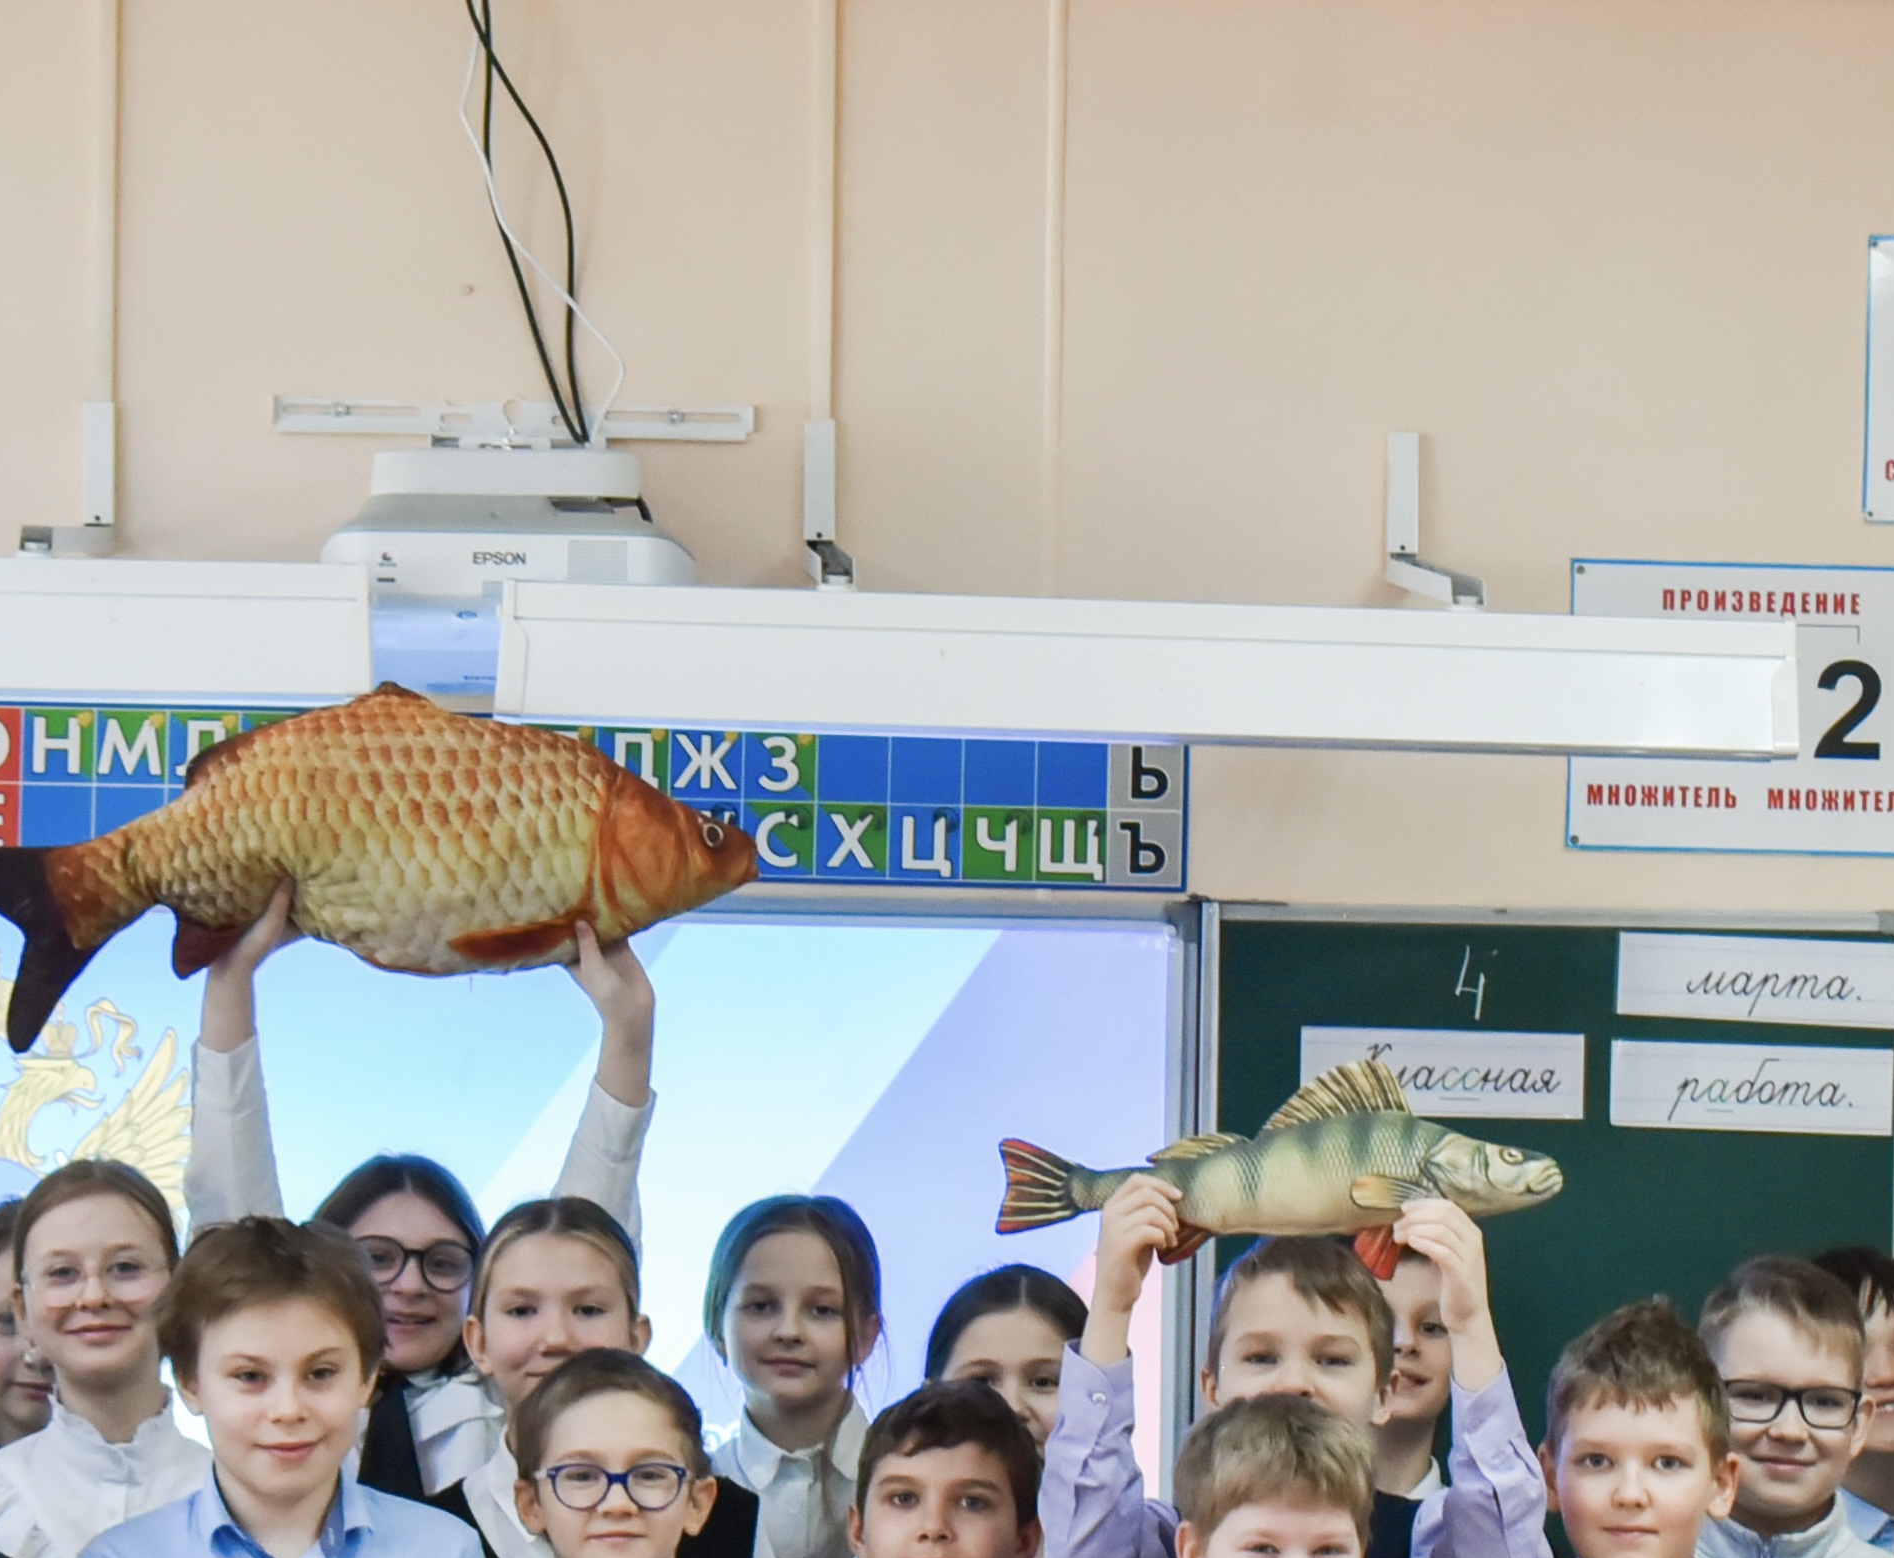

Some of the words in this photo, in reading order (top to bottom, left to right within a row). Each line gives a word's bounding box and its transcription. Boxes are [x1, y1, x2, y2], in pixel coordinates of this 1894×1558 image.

[473, 552, 527, 566] EPSON
[1662, 589, 1862, 618] ПРОИЗВЕДЕНИЕ
[1813, 659, 1883, 761] 2
[1587, 784, 1738, 810] МНОЖИТЕЛЬ
[1454, 945, 1486, 1020] 4
[1686, 965, 1863, 1017] марта.
[1667, 1057, 1854, 1122] работа.
